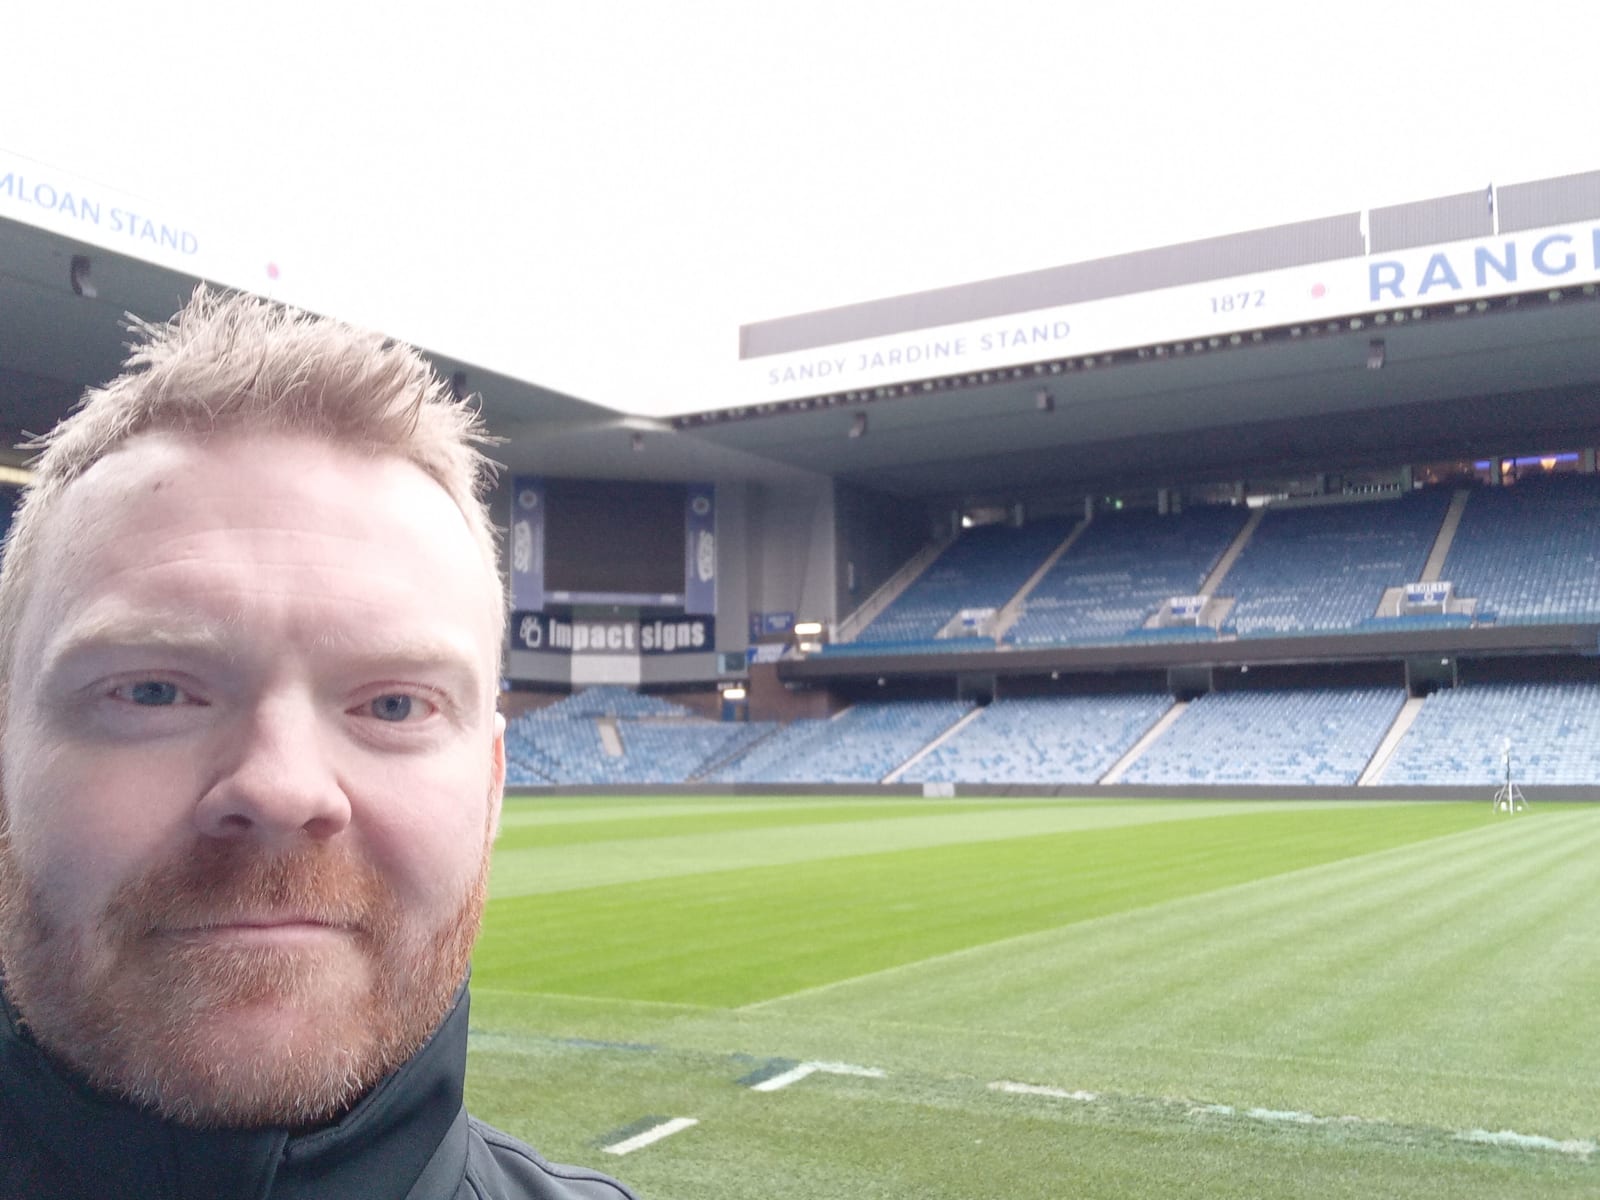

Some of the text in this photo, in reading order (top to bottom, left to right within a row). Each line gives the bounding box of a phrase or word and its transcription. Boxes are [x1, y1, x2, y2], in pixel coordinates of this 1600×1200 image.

[110, 207, 199, 255] STAND
[1368, 229, 1600, 302] RANG
[1209, 289, 1266, 314] 1872
[769, 320, 1071, 385] SANDY JARDINE STAND
[641, 619, 705, 650] signs
